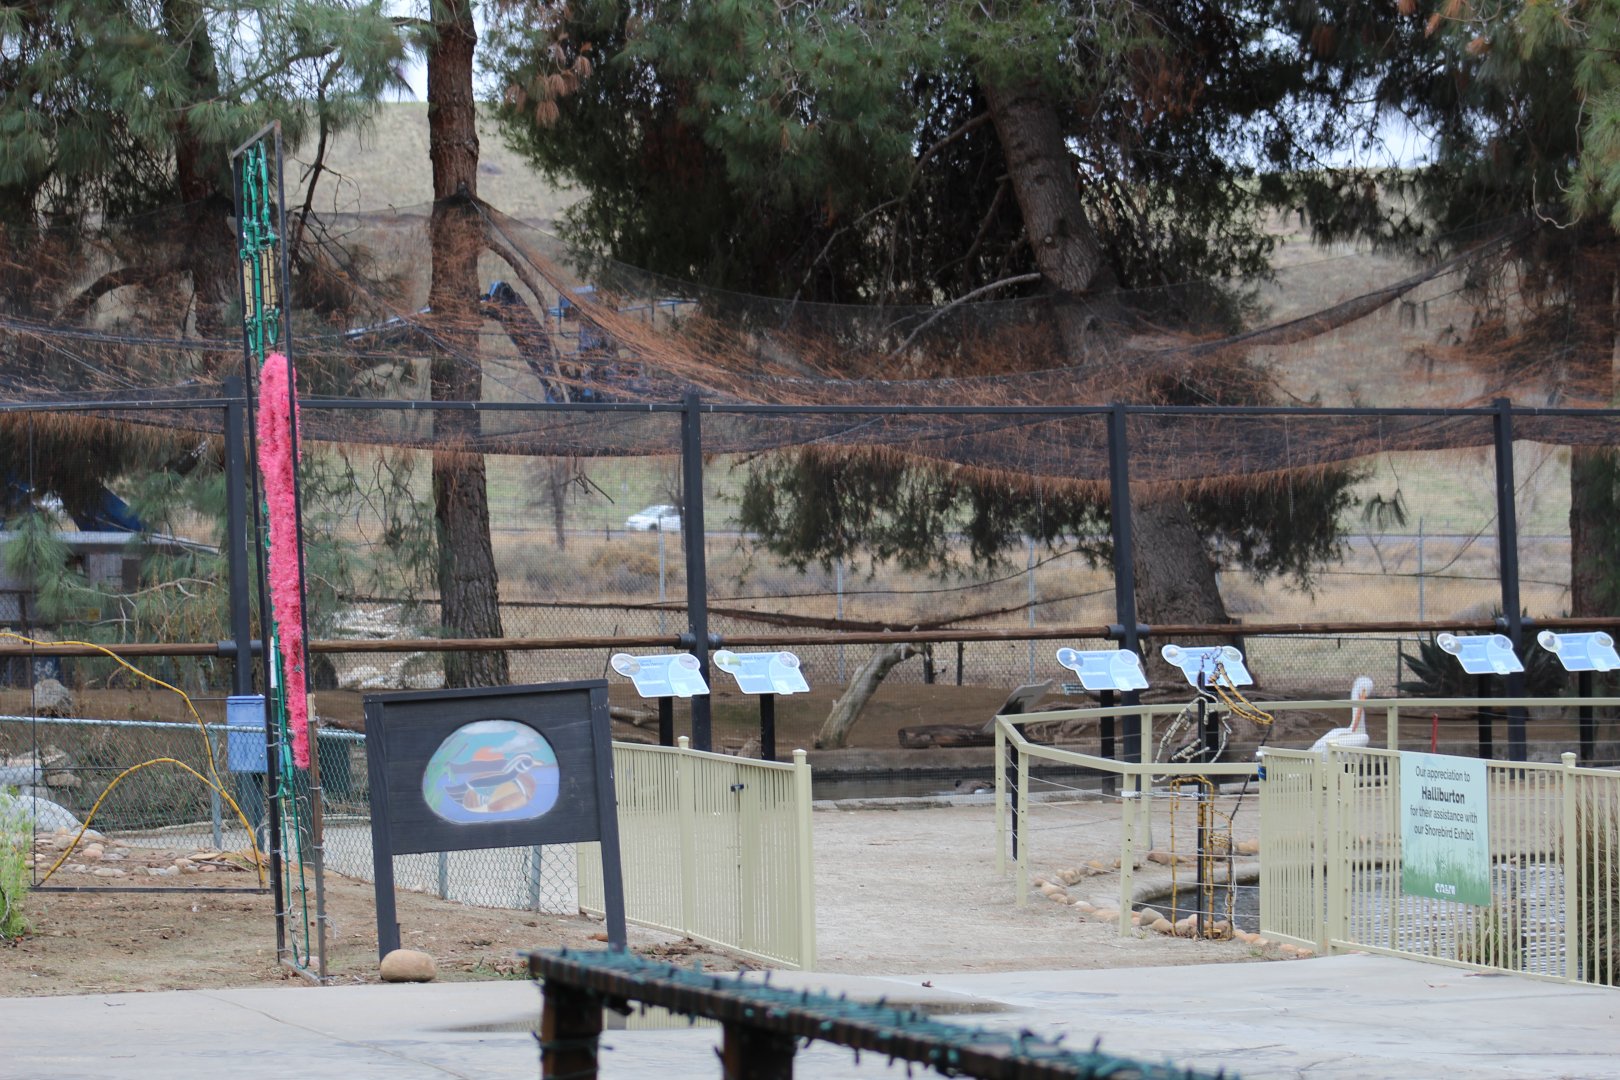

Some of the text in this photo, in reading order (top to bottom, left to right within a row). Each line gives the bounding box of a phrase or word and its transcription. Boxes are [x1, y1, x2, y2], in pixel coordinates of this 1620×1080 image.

[1415, 765, 1471, 782] Our appreciation to
[1421, 786, 1465, 804] Halliburton
[1410, 804, 1478, 824] for their assistance with
[1414, 824, 1475, 841] our Shorebird Exhibit
